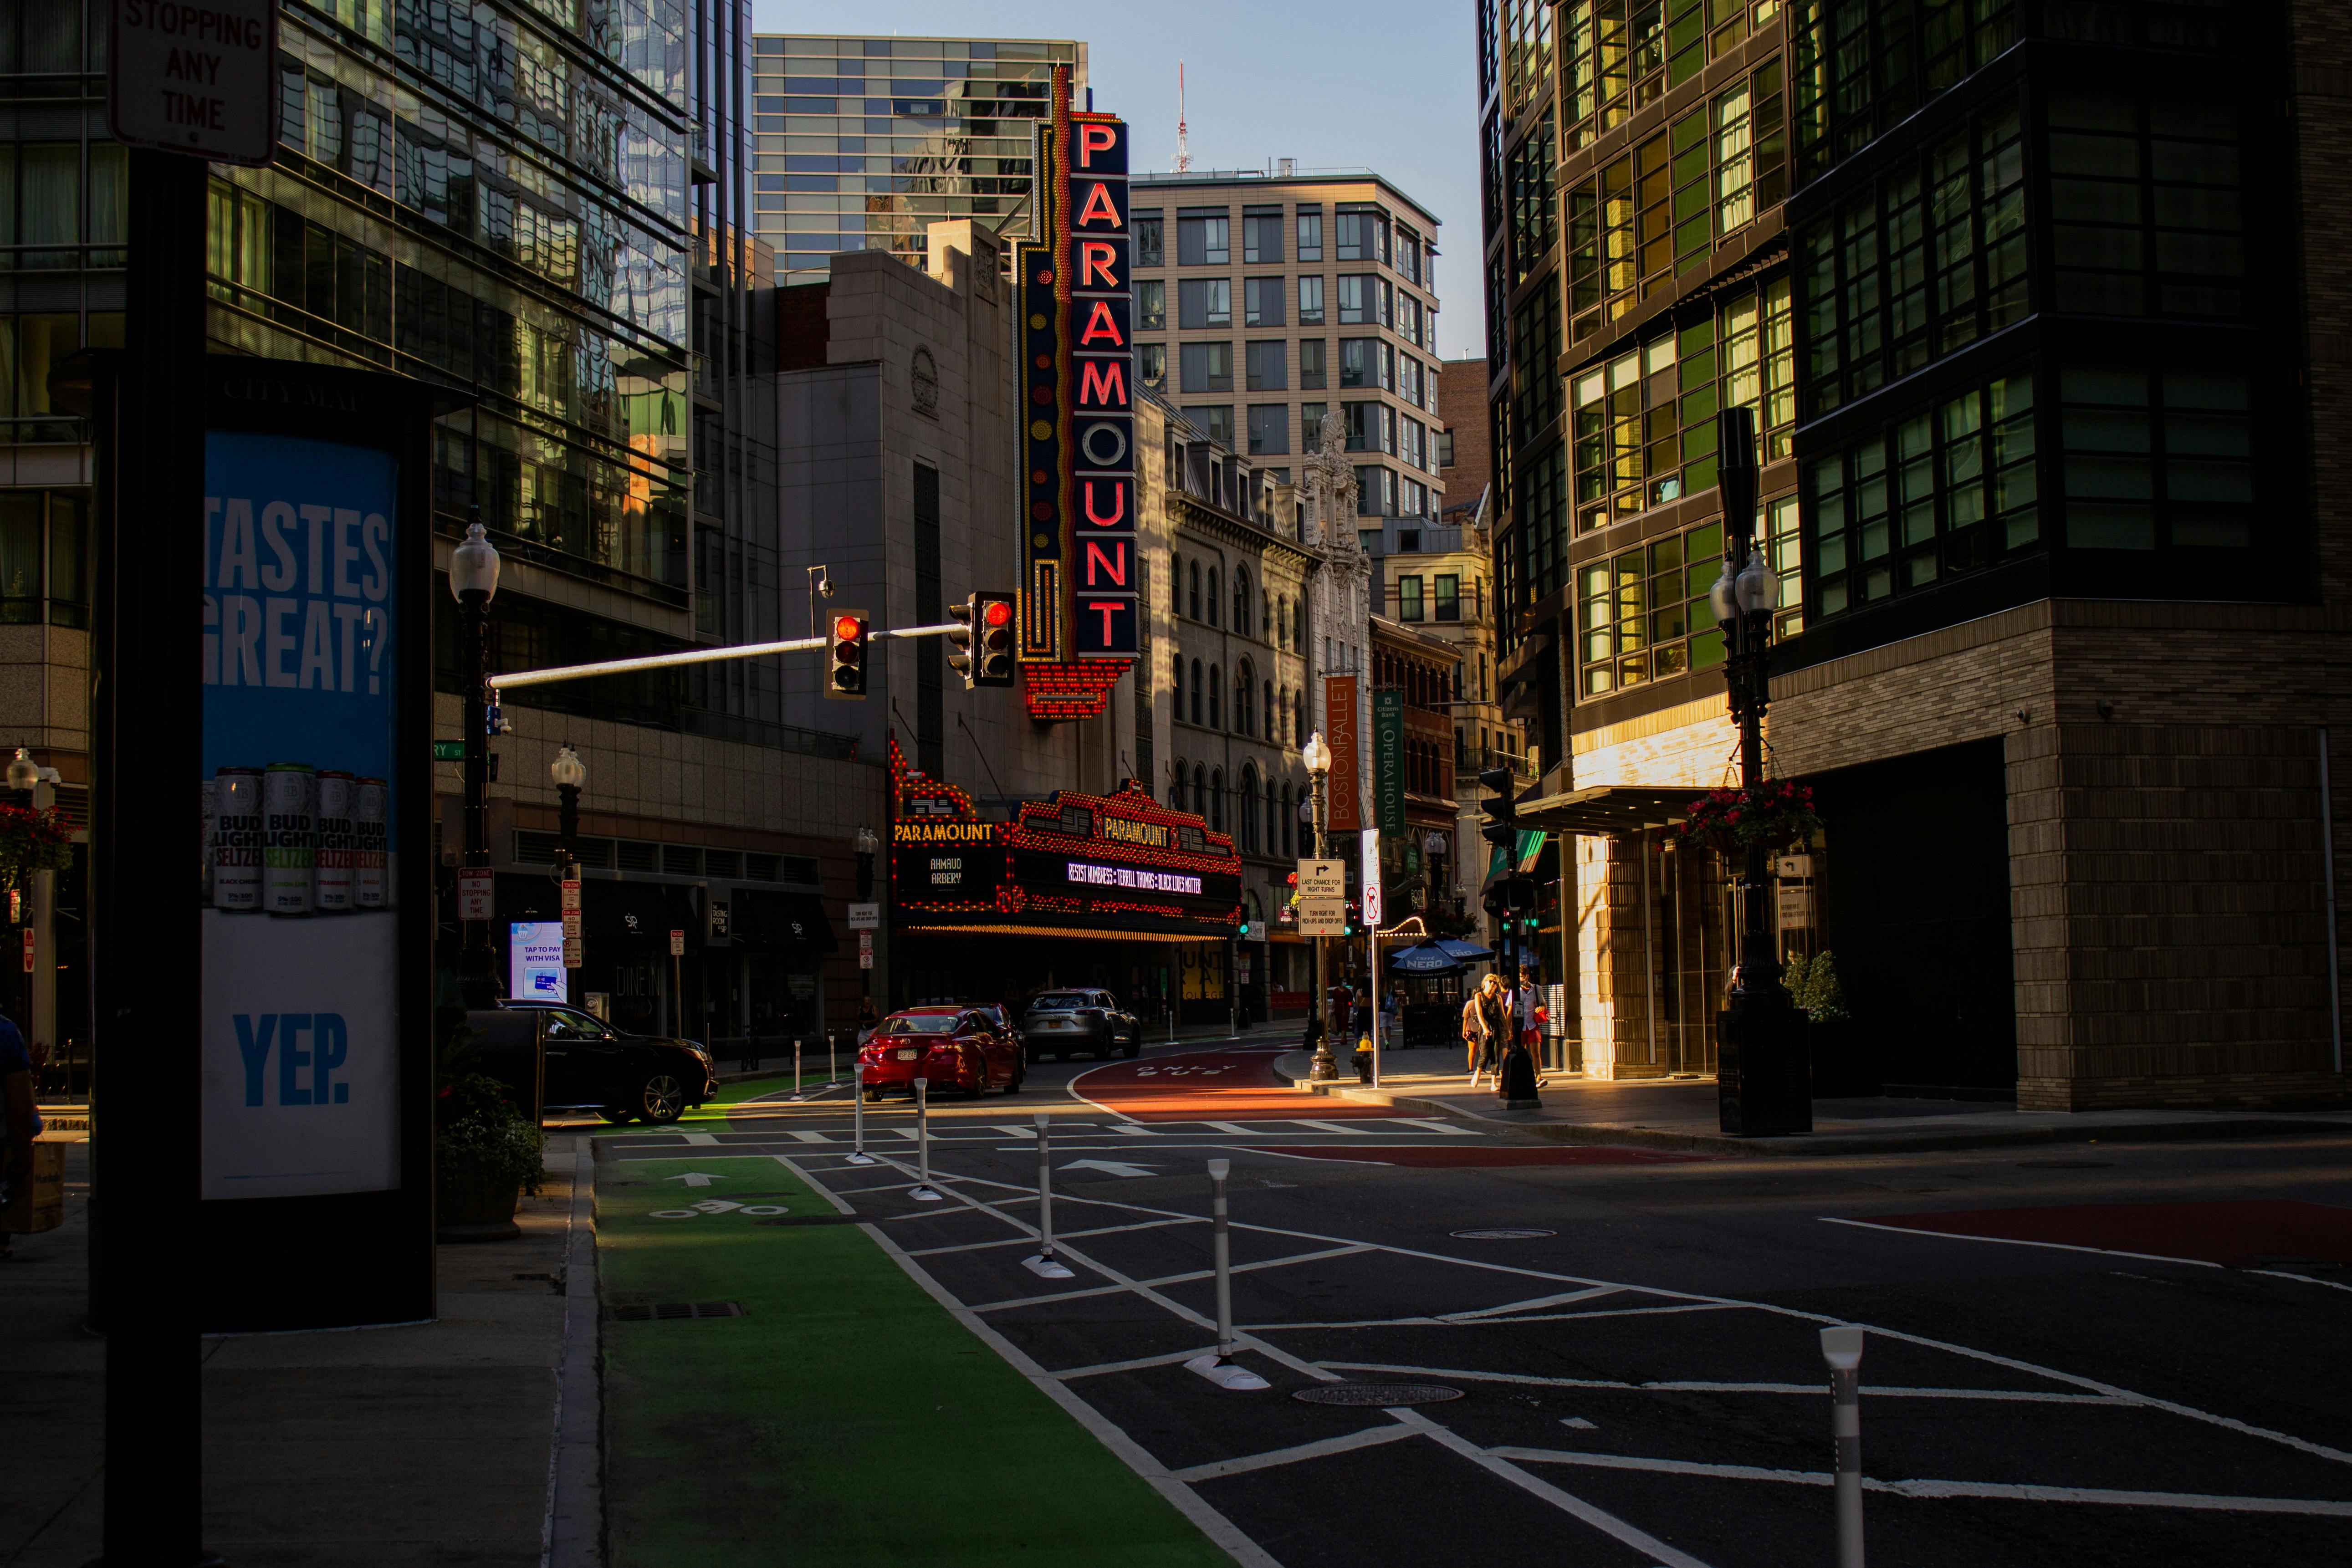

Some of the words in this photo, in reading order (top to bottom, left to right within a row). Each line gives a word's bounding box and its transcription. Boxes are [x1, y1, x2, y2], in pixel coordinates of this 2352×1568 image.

[126, 0, 261, 50] STOPPING
[167, 48, 222, 85] ANY
[163, 91, 225, 131] TIME
[224, 376, 294, 403] CITY
[302, 383, 365, 411] MAP
[1079, 124, 1126, 647] PARAMOUNT
[204, 496, 389, 602] TASTES
[1383, 730, 1396, 778] OPERA
[1384, 781, 1396, 830] HOUSE
[220, 816, 262, 831] BUD
[270, 815, 310, 831] BUD
[319, 818, 351, 833] BUD
[357, 822, 384, 836] BUD
[894, 823, 993, 842] PARAMOUNT
[1104, 817, 1168, 848] PARAMOUNT
[264, 832, 315, 848] LIGHT
[266, 848, 313, 869] SELTZER
[931, 858, 961, 870] AHMAUD
[931, 872, 961, 884] ARBERY
[1069, 863, 1087, 882] RESIST
[1087, 865, 1113, 885] NUMBNESS
[1117, 869, 1136, 888] TERRILL
[1137, 871, 1154, 889] THOMAS
[1158, 873, 1172, 891] BLACK
[1172, 875, 1185, 892] LIVES
[1185, 877, 1202, 894] MATTER
[1407, 960, 1443, 968] NERO
[617, 965, 645, 997] DINE
[649, 966, 660, 997] IN
[233, 1013, 348, 1107] YEP.
